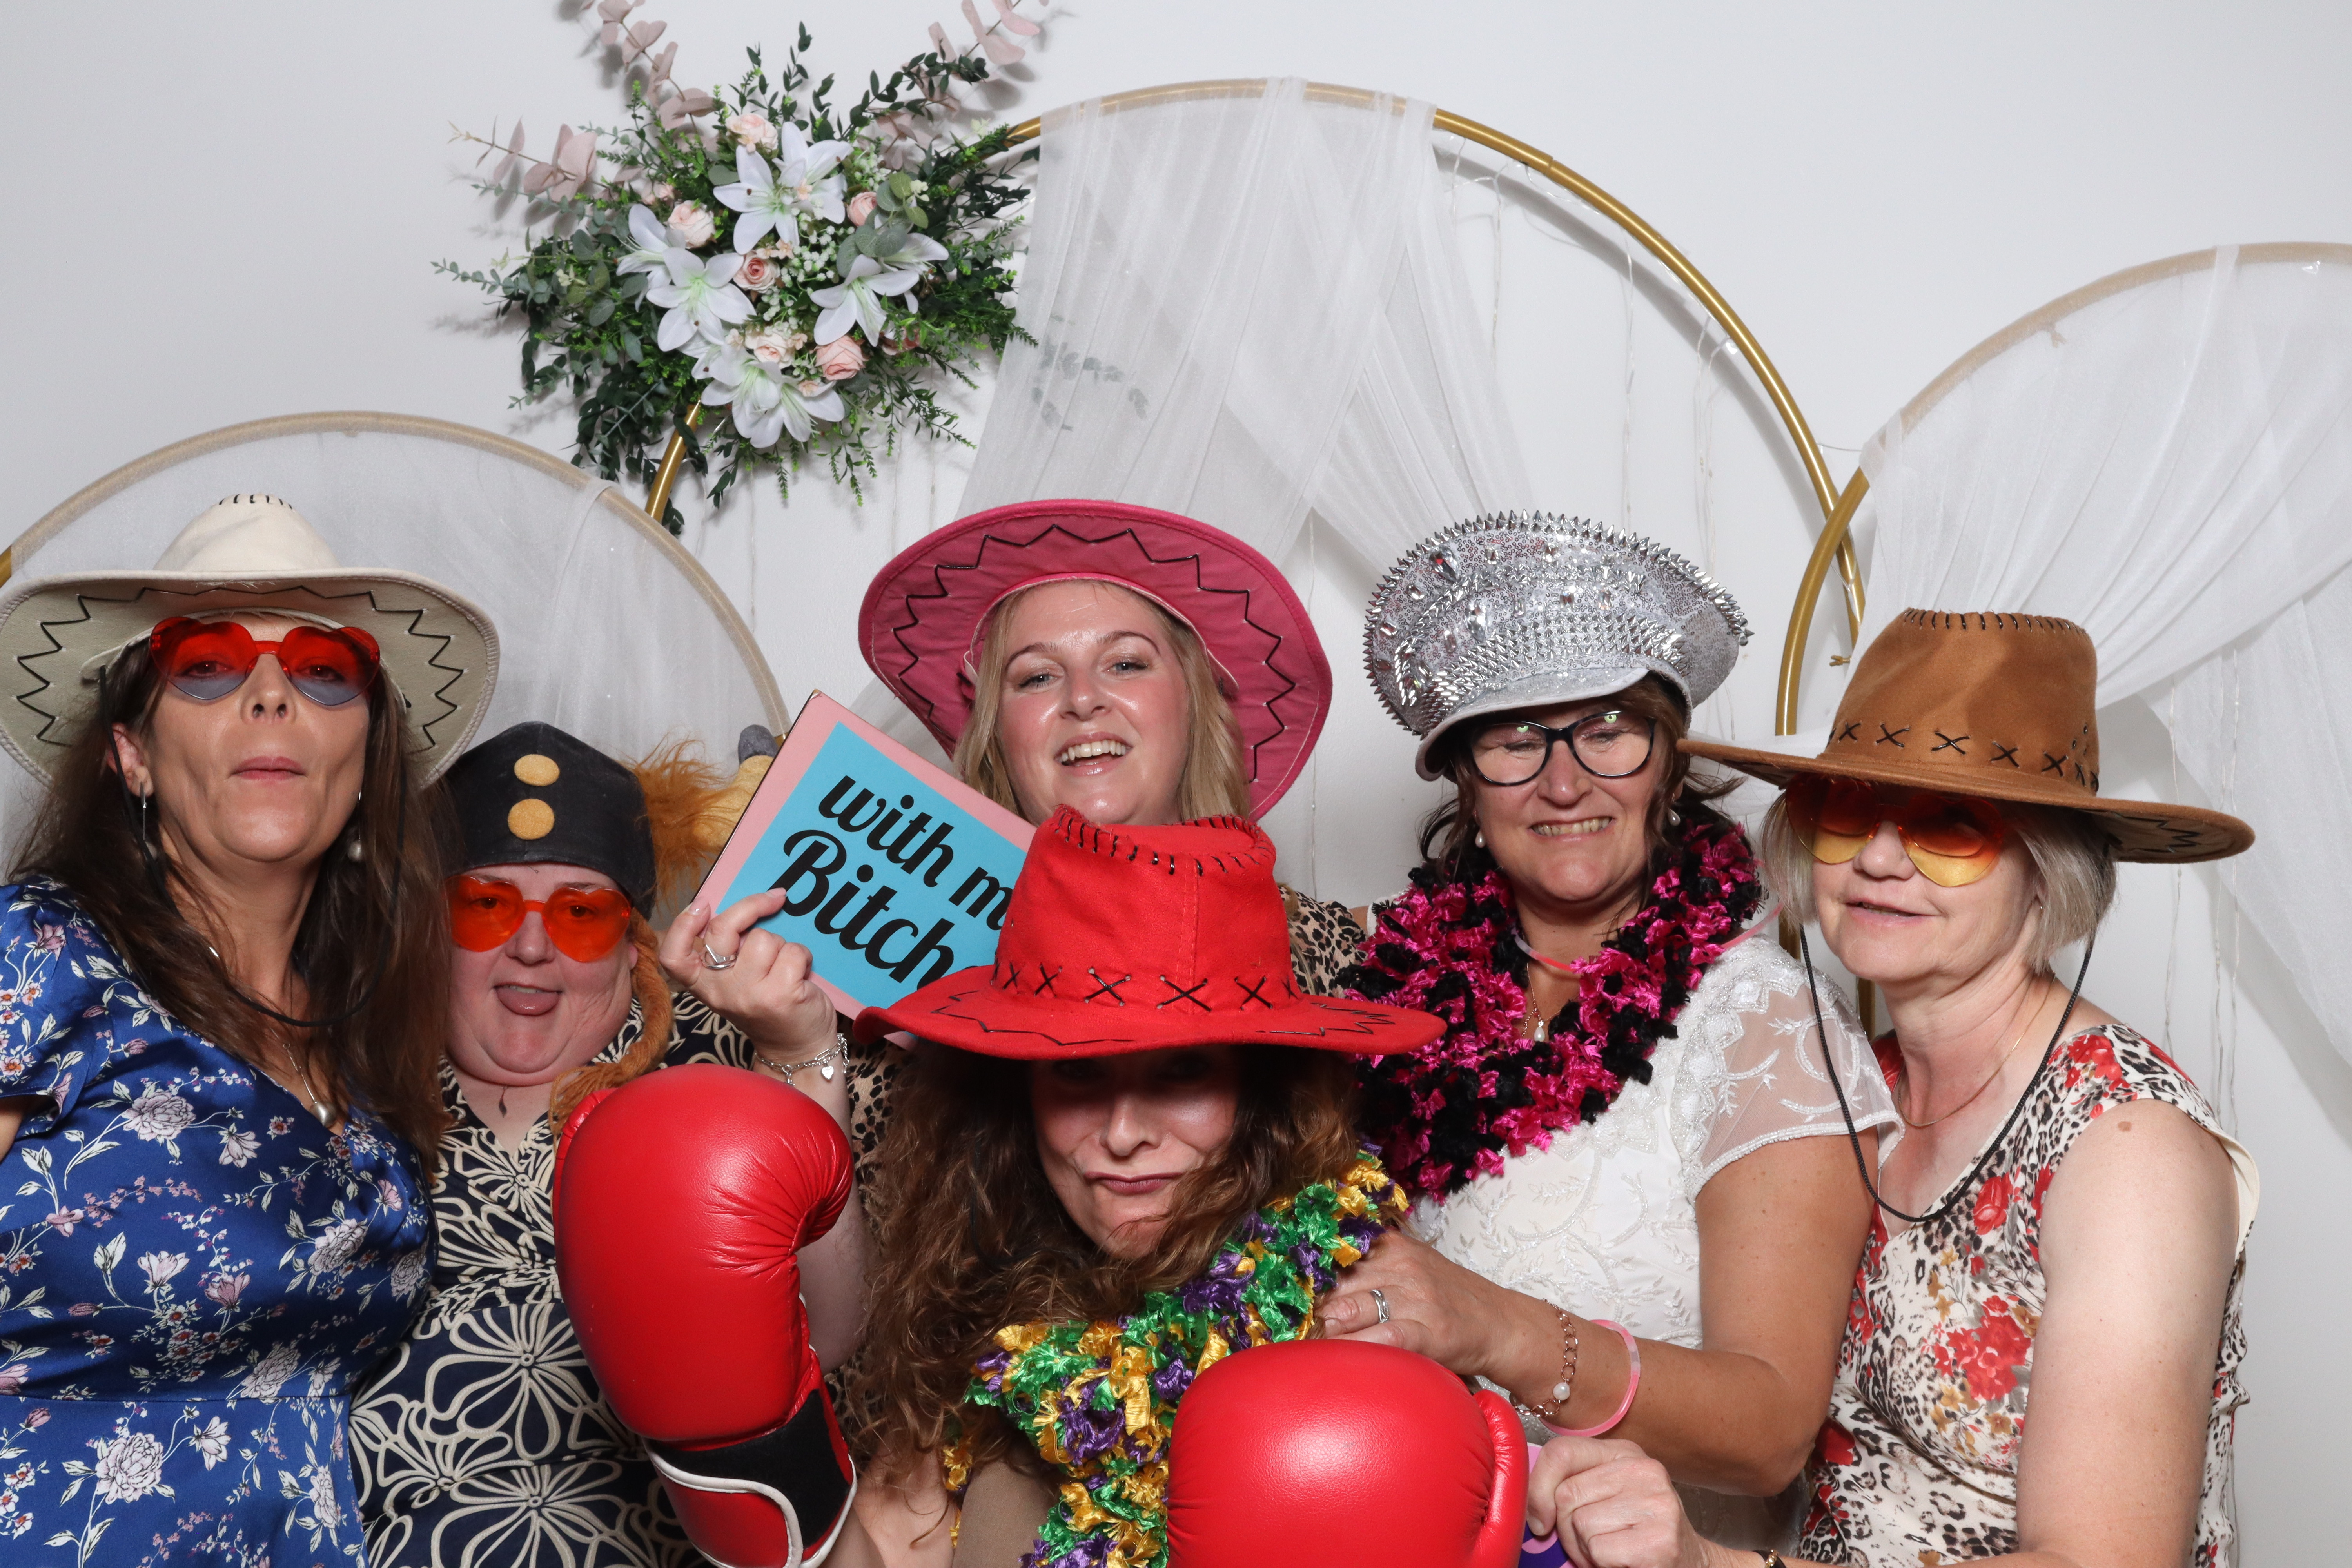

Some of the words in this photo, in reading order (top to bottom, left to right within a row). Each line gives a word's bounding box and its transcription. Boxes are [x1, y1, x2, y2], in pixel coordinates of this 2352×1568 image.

[768, 829, 978, 991] Bitch
[818, 775, 955, 888] with
[949, 867, 1013, 931] m
